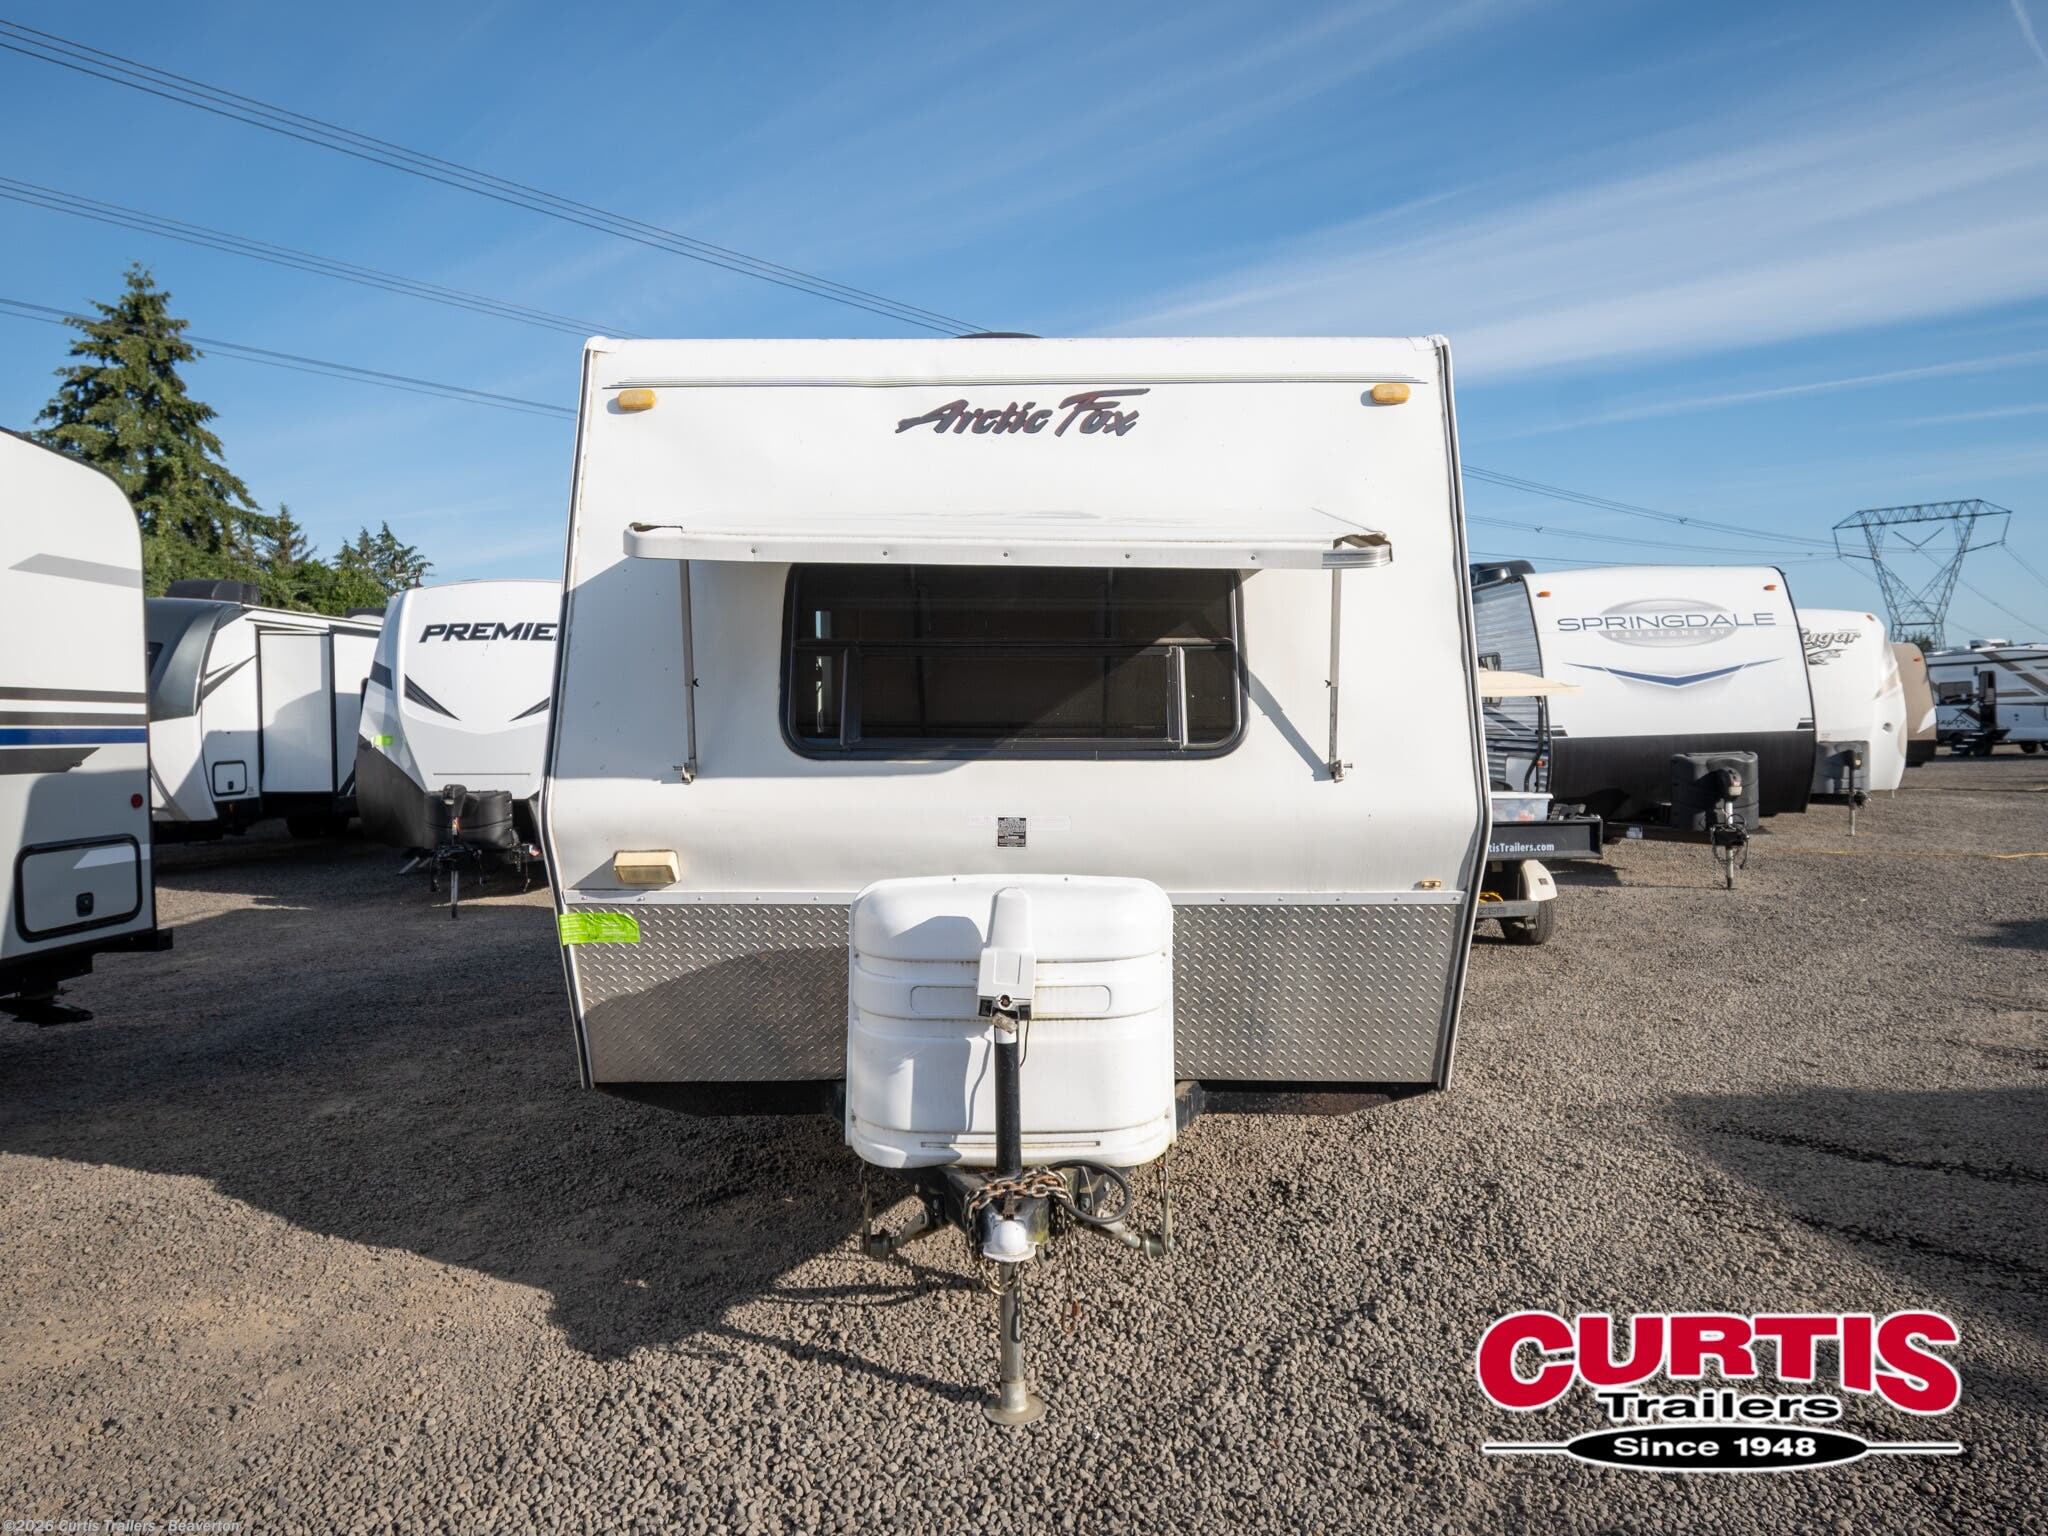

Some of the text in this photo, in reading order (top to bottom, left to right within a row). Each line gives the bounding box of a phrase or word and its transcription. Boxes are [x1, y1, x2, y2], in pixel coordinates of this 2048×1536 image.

[895, 387, 1151, 437] Arctic Fox
[1557, 612, 1777, 632] SPRINGDALE
[418, 622, 558, 644] PREMIE
[1611, 627, 1726, 639] KEYSTONE RV
[1800, 627, 1862, 649] ugar
[1488, 842, 1554, 852] tisTrailers.com
